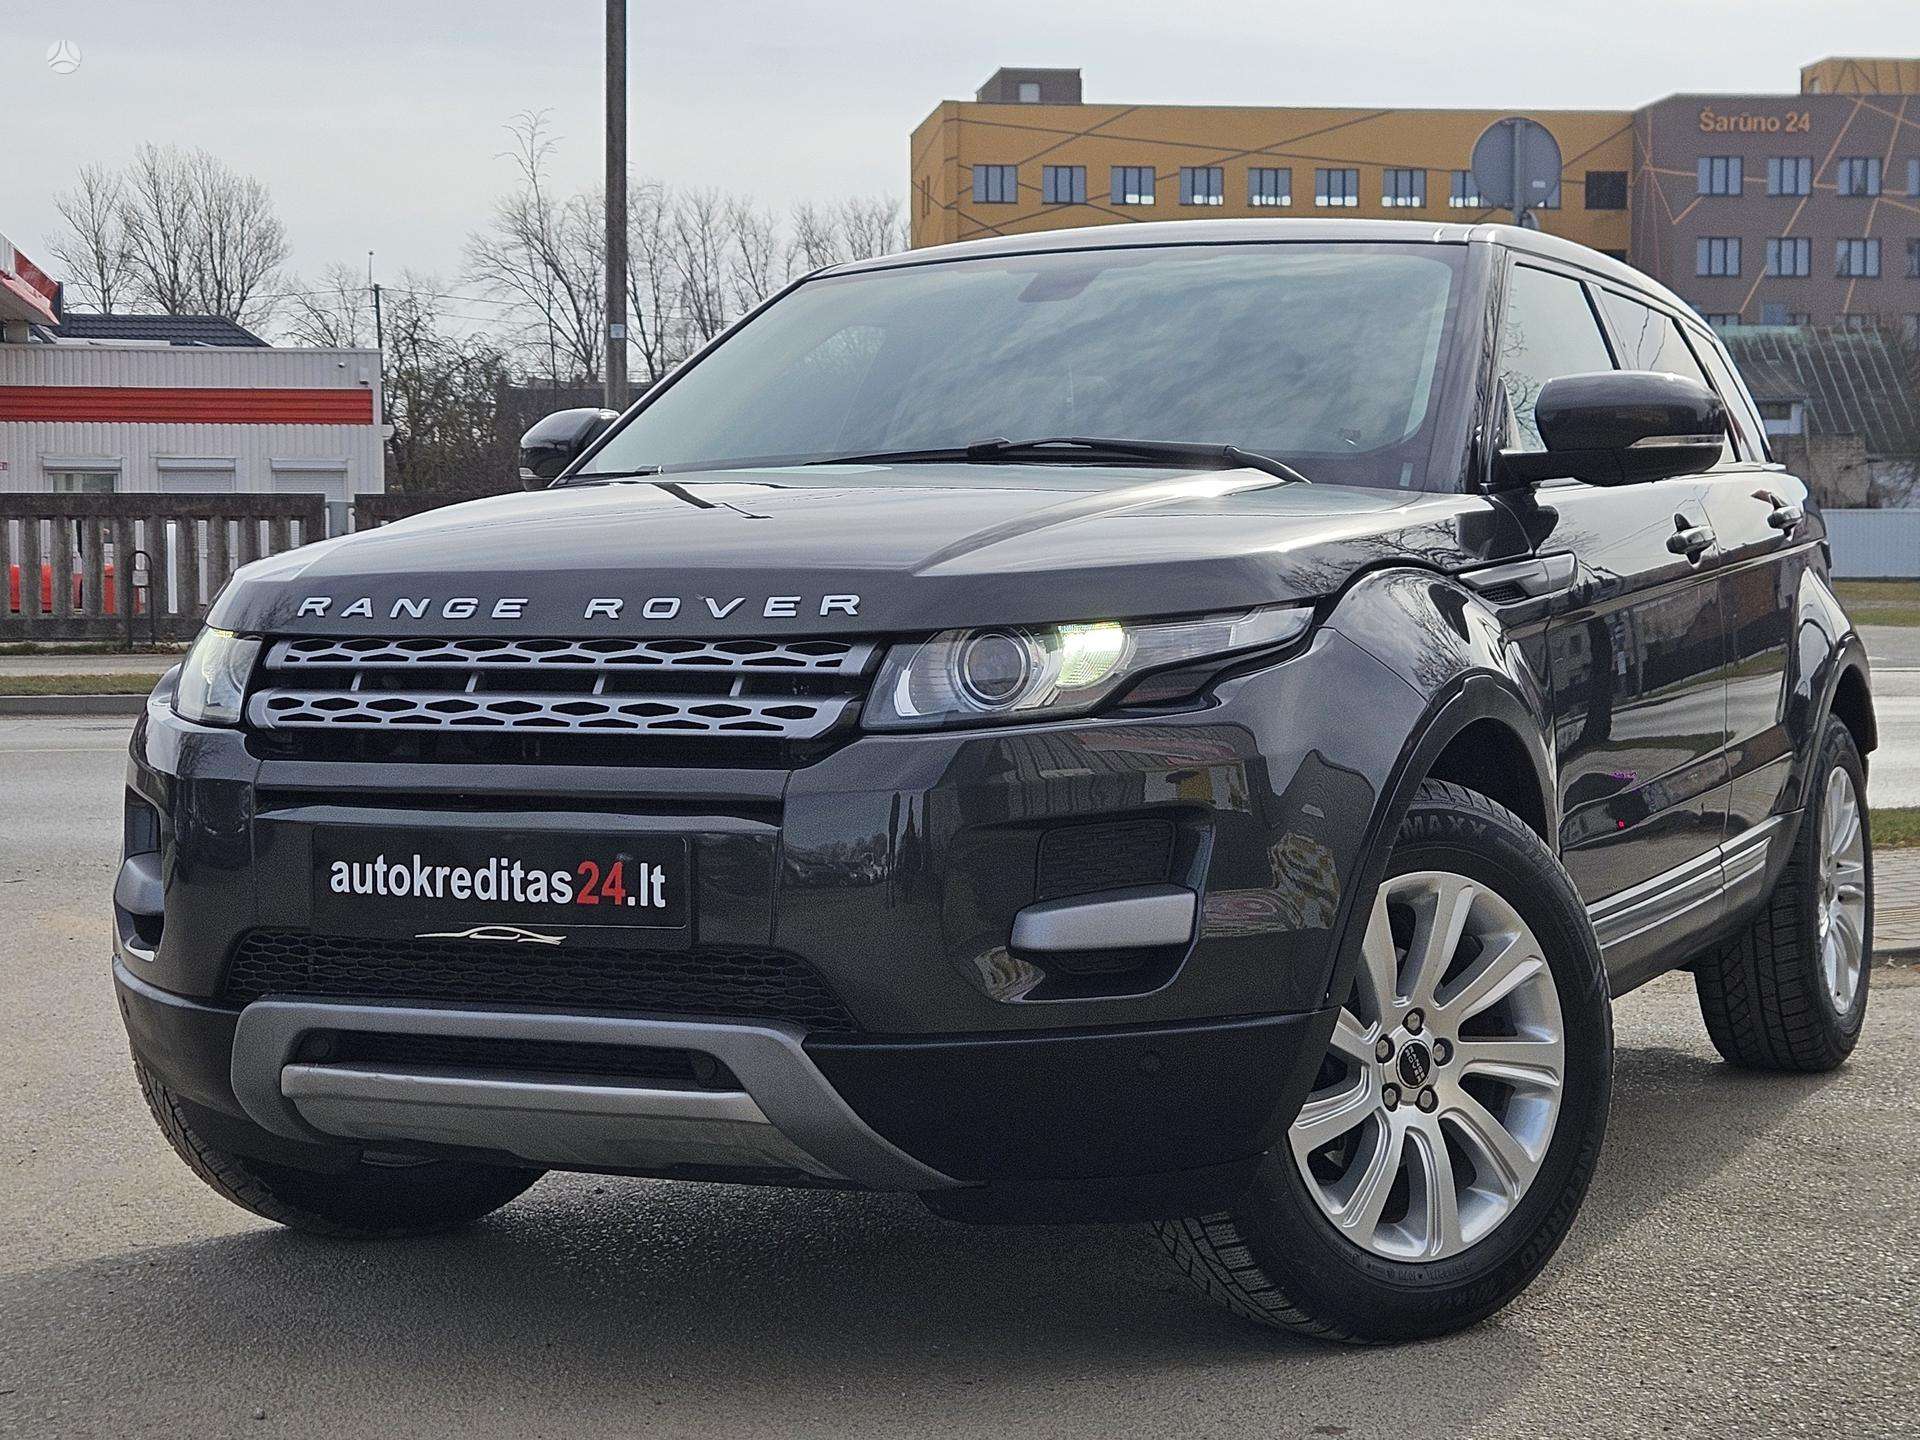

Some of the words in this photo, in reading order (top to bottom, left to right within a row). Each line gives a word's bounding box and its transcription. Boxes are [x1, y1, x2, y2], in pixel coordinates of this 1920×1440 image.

[1699, 105, 1780, 132] Šarūno
[1785, 111, 1811, 132] 24
[297, 597, 529, 619] RANGE
[584, 594, 861, 618] ROVER
[329, 853, 667, 908] autokreditas24.lt
[1404, 1049, 1422, 1083] ROVER
[1408, 1045, 1426, 1079] RANGE
